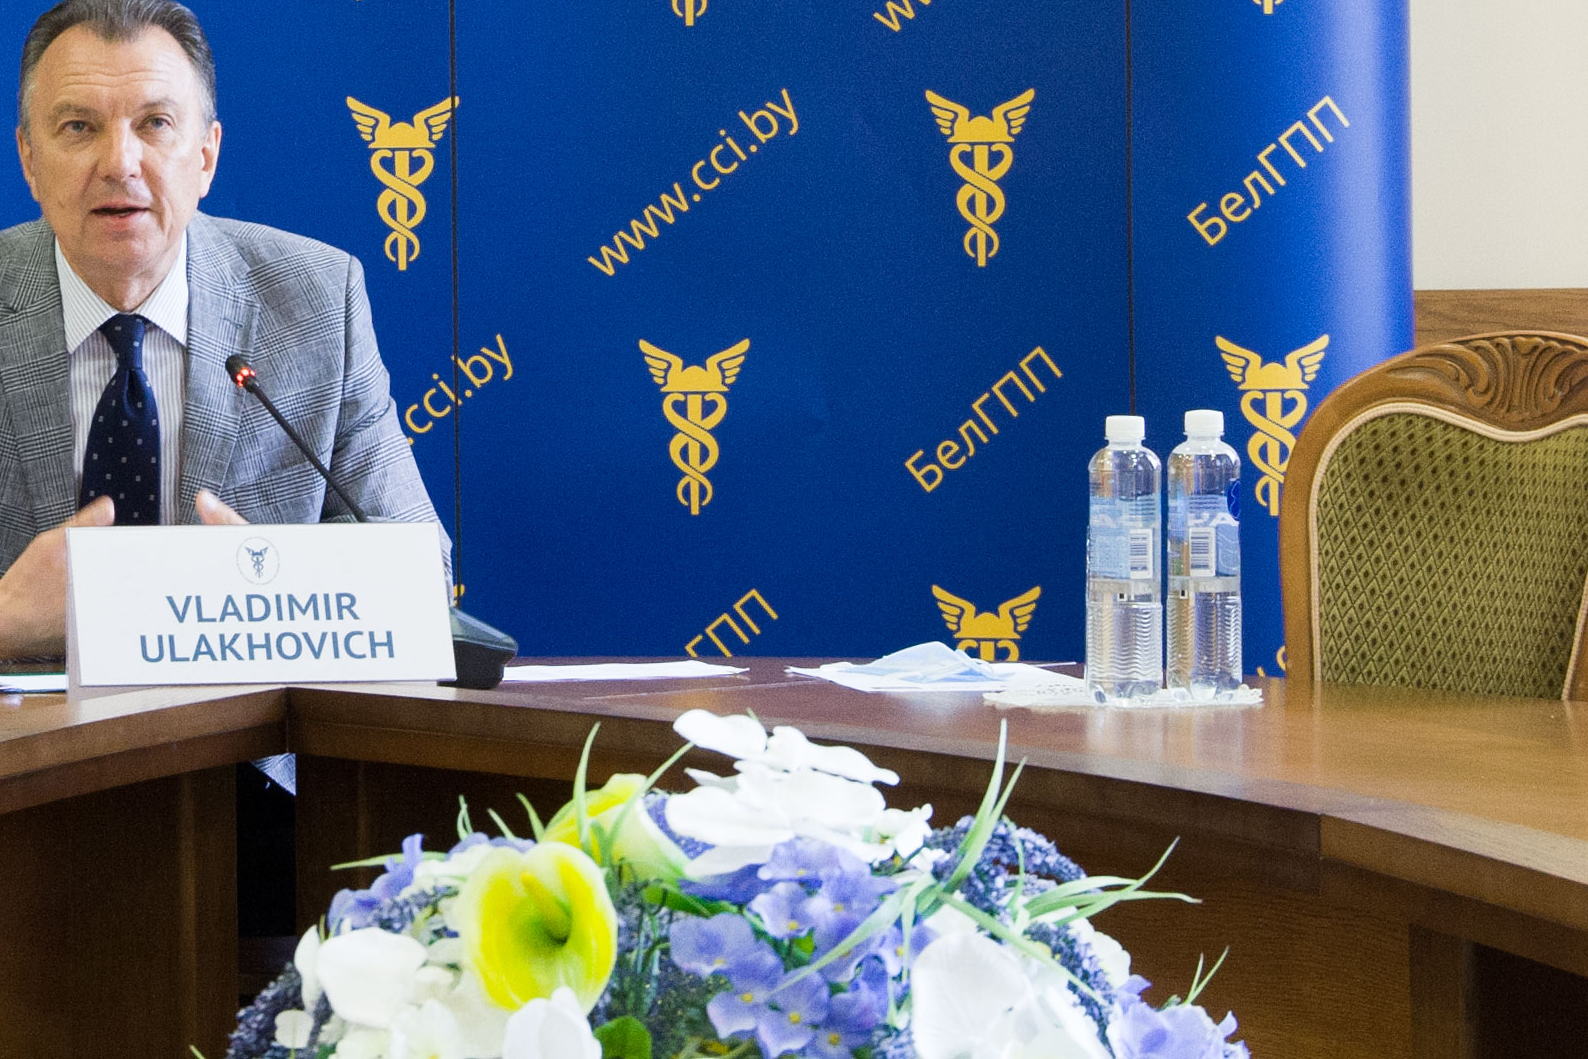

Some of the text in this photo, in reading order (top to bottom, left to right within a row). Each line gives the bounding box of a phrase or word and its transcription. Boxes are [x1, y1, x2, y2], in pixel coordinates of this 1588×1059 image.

[586, 87, 800, 277] www.cci.by
[1186, 95, 1350, 246] БелГПП
[405, 333, 514, 445] .cci.by
[903, 345, 1064, 493] БелГПП
[139, 630, 395, 663] ULAKHOVICH
[165, 592, 360, 623] VLADIMIR
